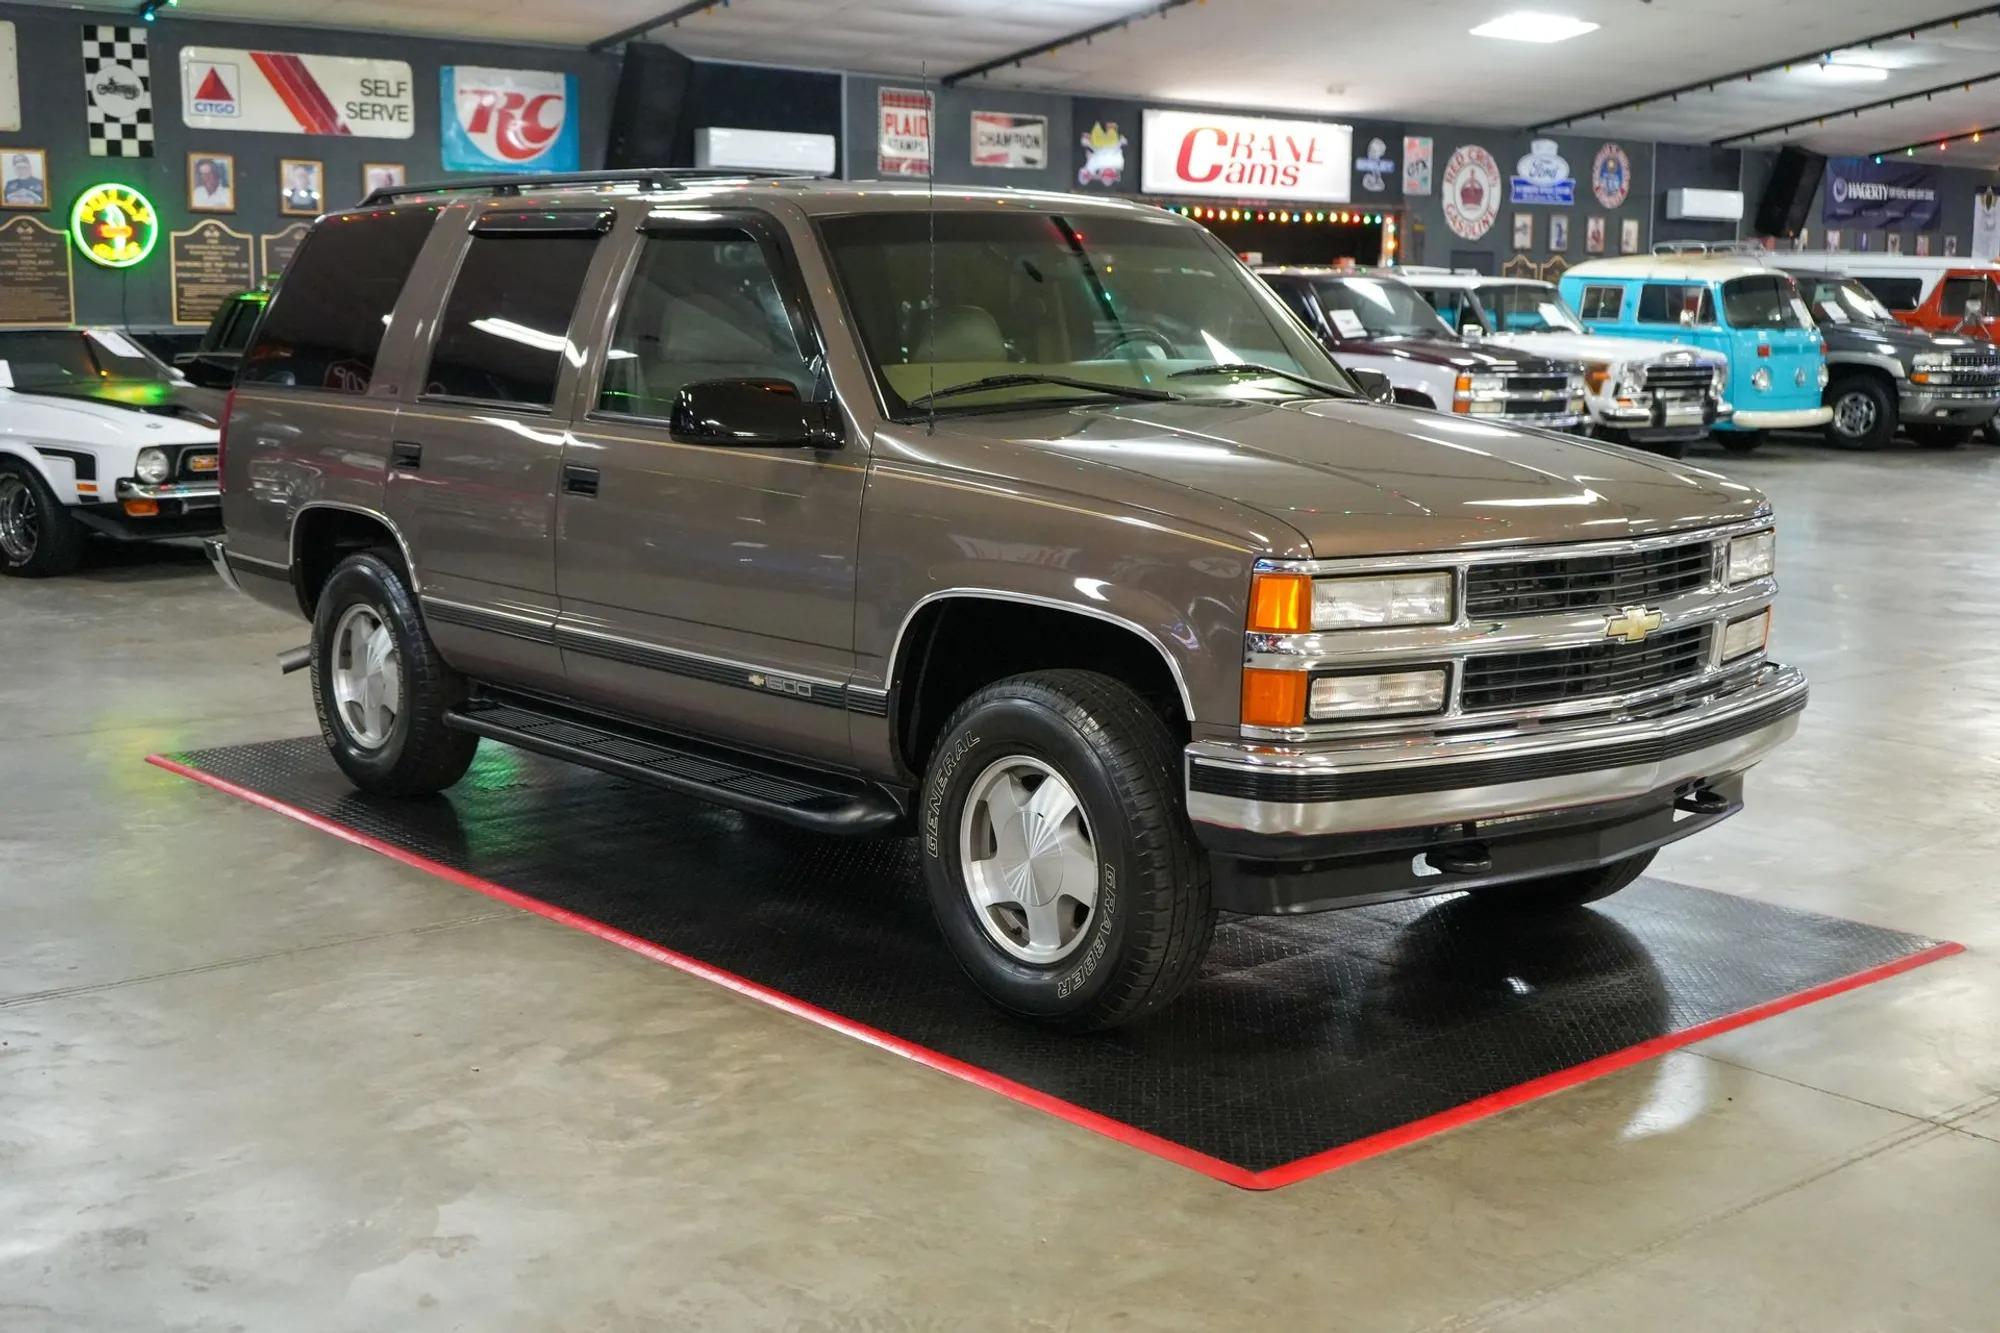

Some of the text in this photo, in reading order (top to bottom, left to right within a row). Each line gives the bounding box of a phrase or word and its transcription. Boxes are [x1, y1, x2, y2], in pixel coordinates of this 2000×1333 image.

[360, 78, 409, 99] SELF
[194, 101, 236, 115] CITGO
[345, 101, 410, 123] SERVE
[458, 87, 564, 161] RC
[978, 130, 1041, 149] CHAMPION
[1848, 182, 1889, 201] HAGERTY
[1445, 202, 1498, 236] GASOLINE
[926, 730, 981, 859] GENERAL
[1057, 863, 1116, 999] GRABBER
